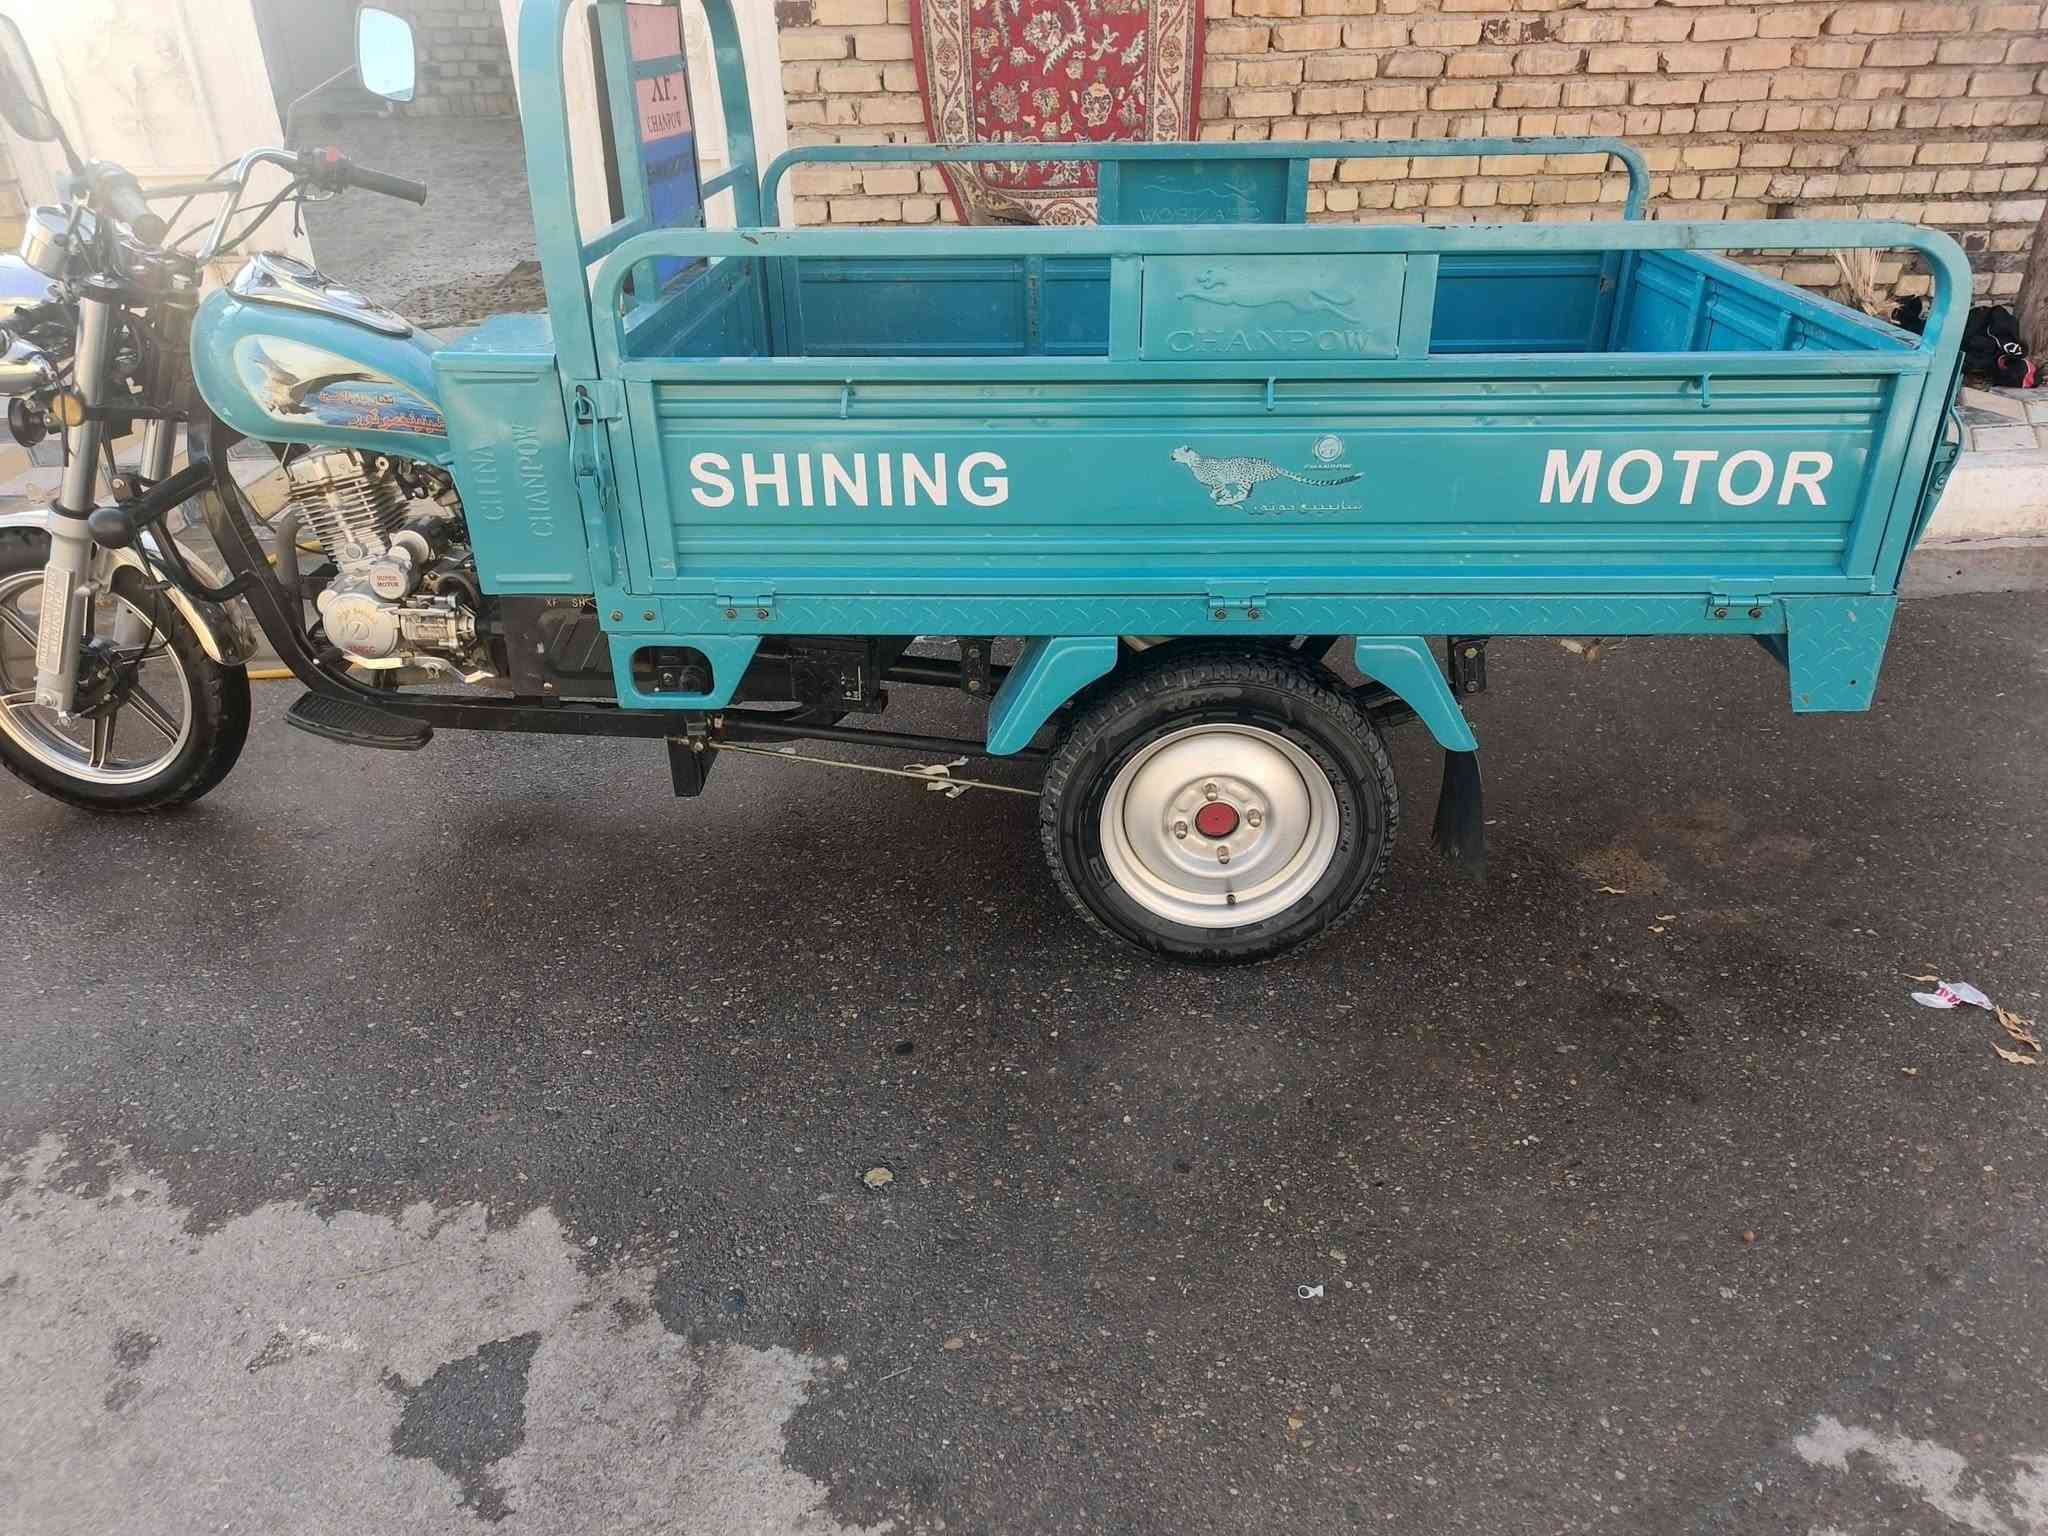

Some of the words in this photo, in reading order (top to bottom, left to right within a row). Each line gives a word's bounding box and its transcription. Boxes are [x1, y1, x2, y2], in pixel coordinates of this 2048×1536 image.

[1166, 329, 1371, 353] CHANPOW
[471, 439, 505, 521] CHINA
[511, 422, 553, 537] CHANPOW
[689, 451, 1009, 508] SHINING
[1539, 448, 1833, 506] MOTOR
